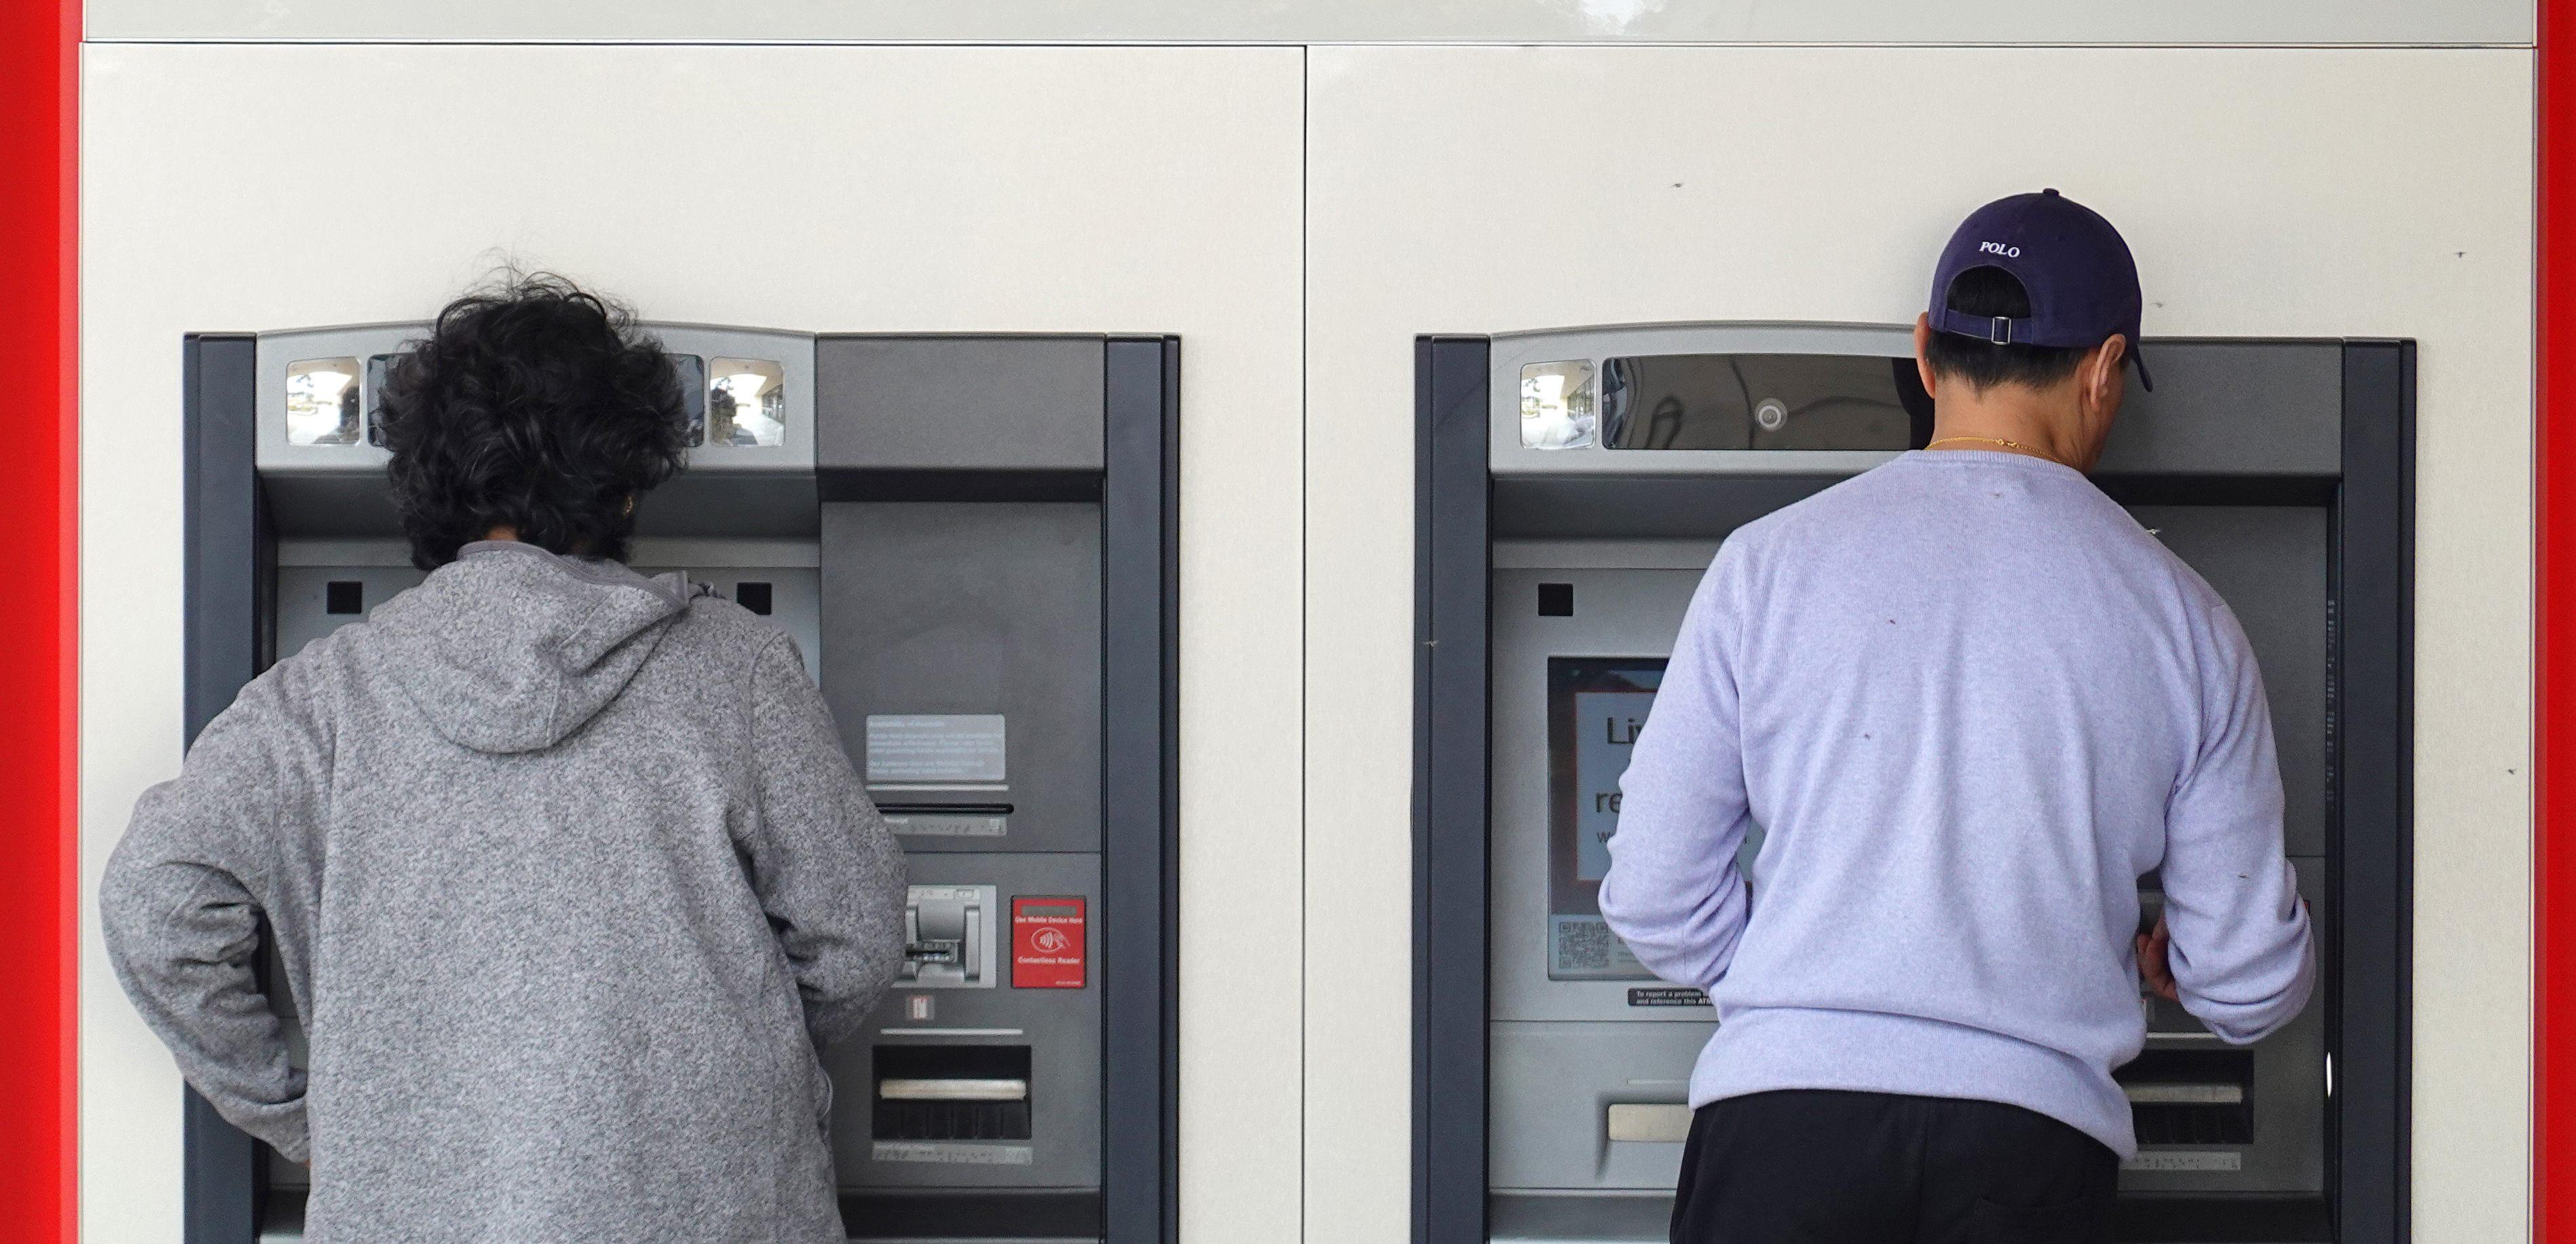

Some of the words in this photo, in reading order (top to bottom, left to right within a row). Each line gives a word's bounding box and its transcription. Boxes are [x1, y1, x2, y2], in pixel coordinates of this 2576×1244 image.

[1979, 241, 2020, 258] POLO
[1048, 916, 1068, 924] Device
[1018, 955, 1056, 964] Contactless
[1057, 956, 1081, 964] Reader
[1645, 991, 1666, 999] report
[1674, 991, 1701, 999] problem
